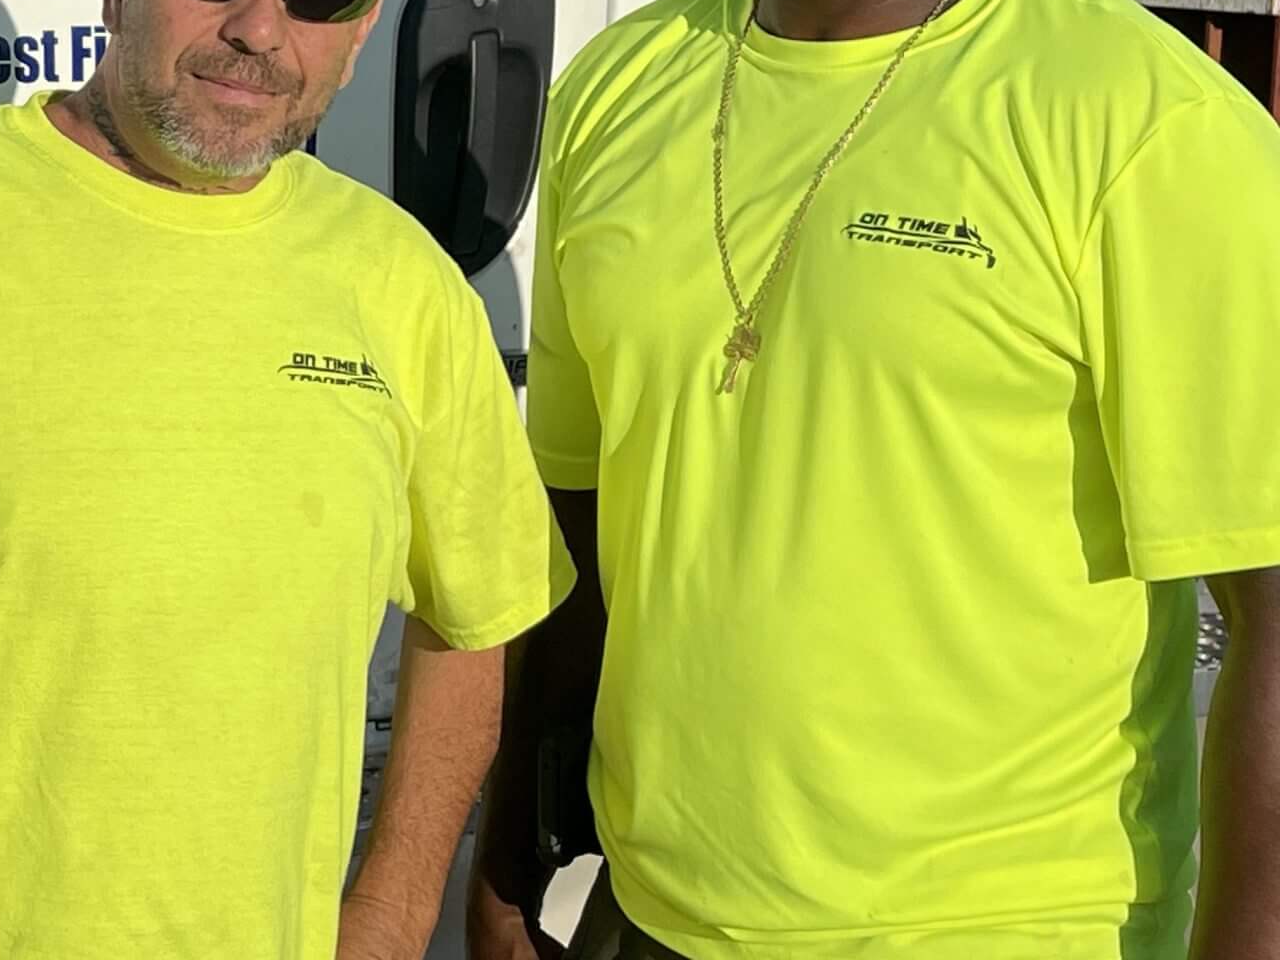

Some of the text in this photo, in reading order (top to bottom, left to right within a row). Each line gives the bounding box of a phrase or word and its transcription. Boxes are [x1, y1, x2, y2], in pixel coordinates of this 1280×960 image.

[859, 212, 951, 235] ON TIME
[846, 230, 983, 259] TRANSPORT
[292, 352, 358, 375] ON TIME
